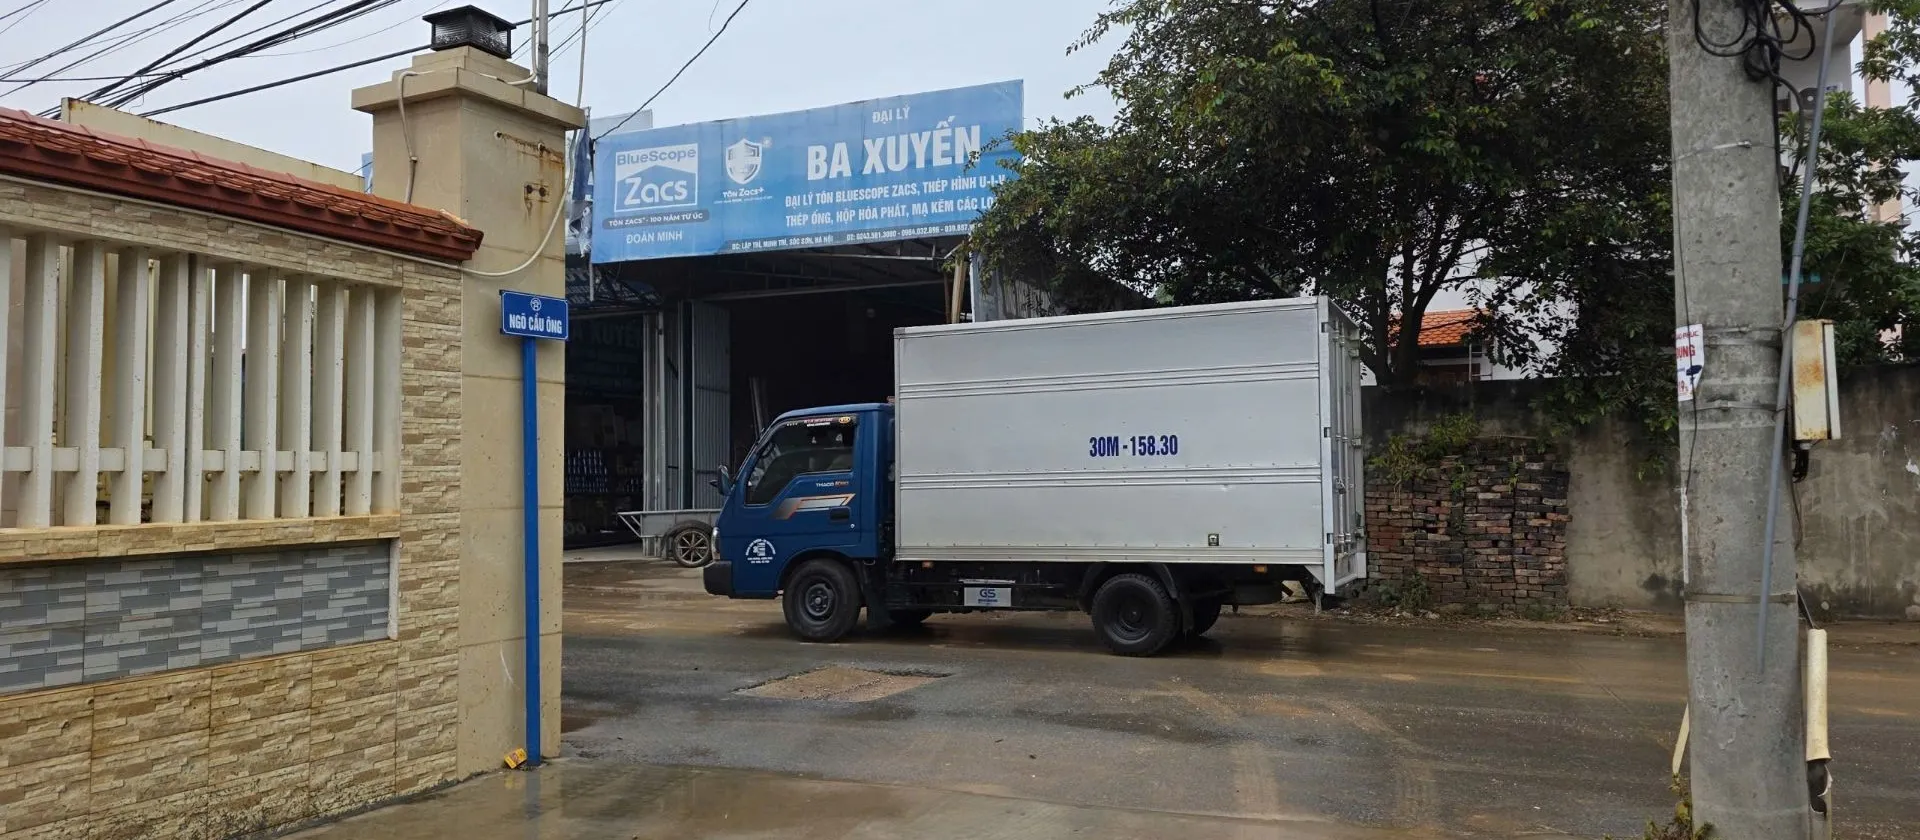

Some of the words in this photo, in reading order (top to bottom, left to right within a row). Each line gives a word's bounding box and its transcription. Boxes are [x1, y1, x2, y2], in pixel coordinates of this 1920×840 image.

[872, 110, 893, 125] ĐẠI
[896, 105, 910, 119] LÝ
[617, 148, 697, 167] BlueScope
[807, 142, 852, 181] BA
[862, 115, 981, 175] XUYẾN
[624, 177, 688, 206] Zacs
[835, 186, 890, 203] BLUESCOPE
[891, 182, 920, 197] ZACS,
[922, 178, 948, 194] THÉP
[951, 176, 977, 191] HÌNH
[785, 212, 809, 228] THÉP
[880, 203, 910, 219] PHÁT,
[911, 202, 929, 217] MẠ
[956, 196, 978, 211] CÁC
[657, 231, 683, 242] MINH
[509, 313, 527, 330] NGÕ
[546, 316, 563, 334] ÔNG
[979, 588, 997, 598] GS
